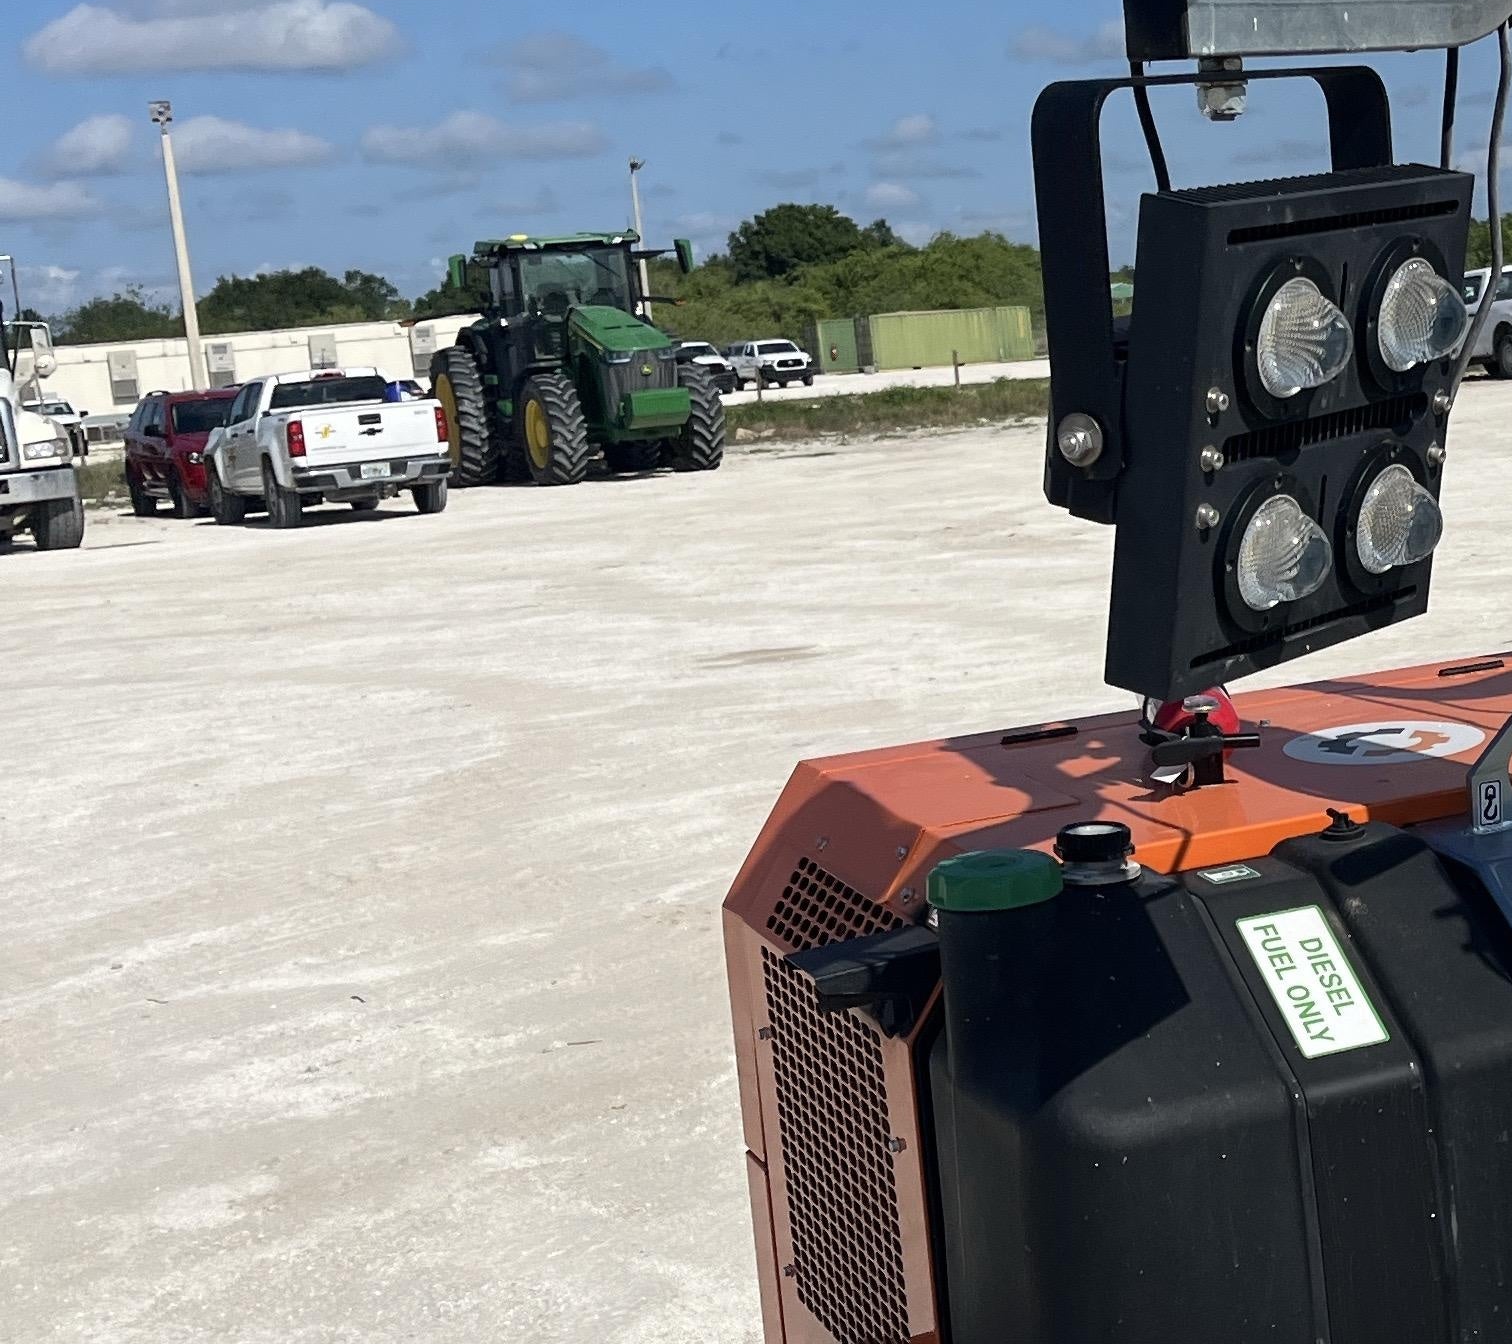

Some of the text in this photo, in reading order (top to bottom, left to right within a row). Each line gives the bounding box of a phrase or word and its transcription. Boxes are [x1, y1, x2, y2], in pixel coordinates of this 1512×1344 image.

[1253, 922, 1337, 1044] FUEL ONLY
[1298, 936, 1356, 1017] DIESEL
